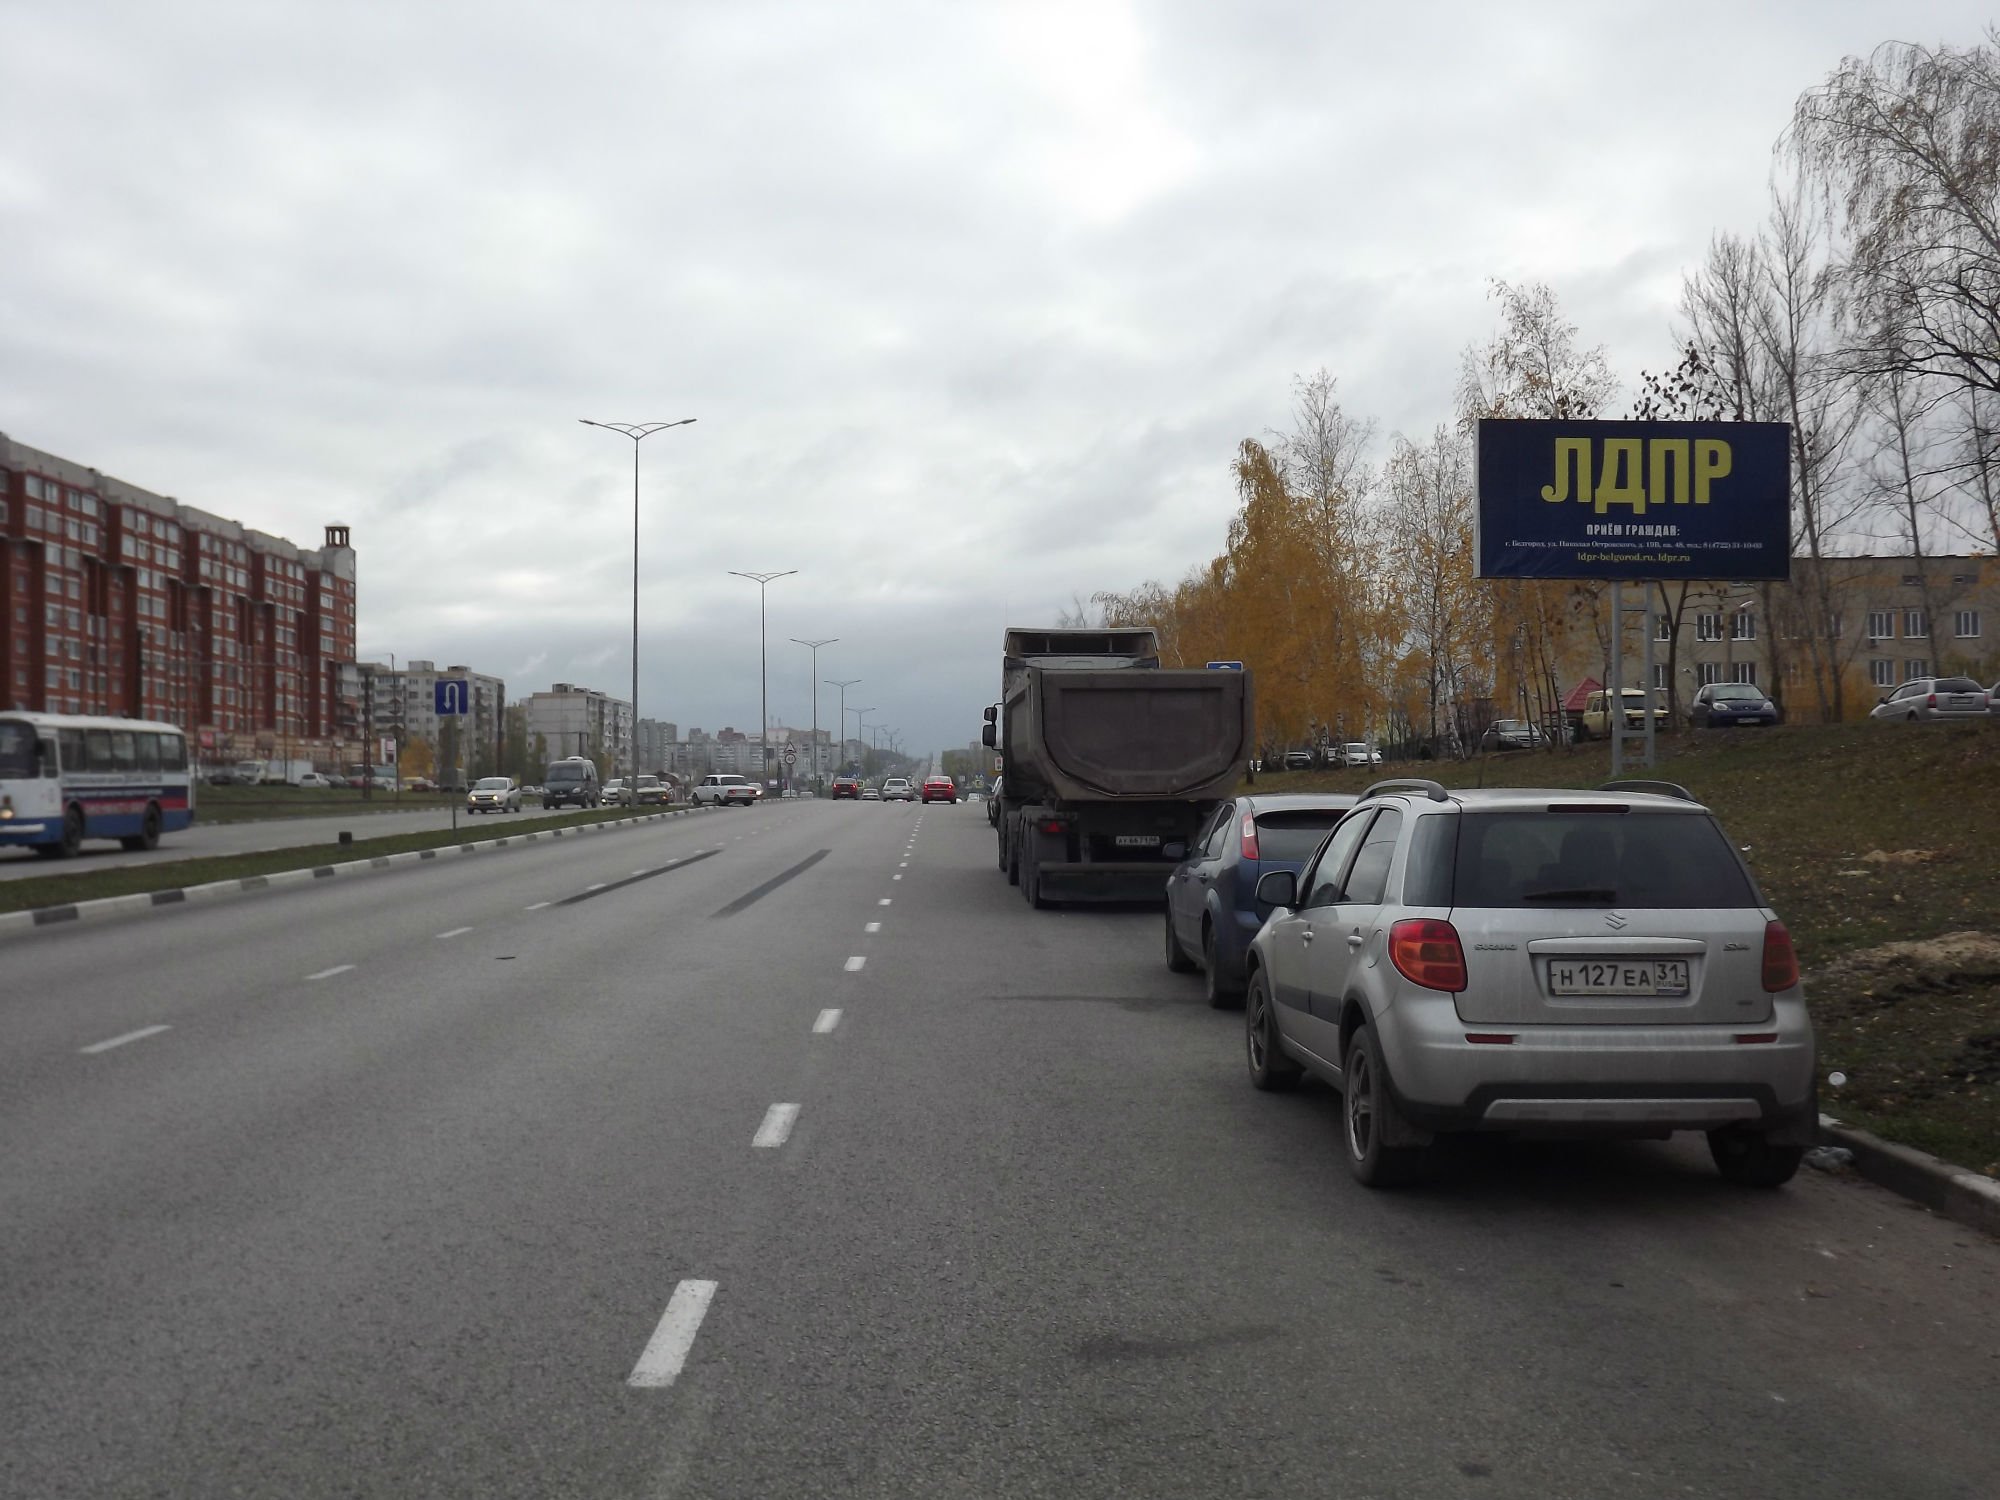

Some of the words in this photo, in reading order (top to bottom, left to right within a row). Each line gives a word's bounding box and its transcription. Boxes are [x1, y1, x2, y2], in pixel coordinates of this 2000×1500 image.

[1540, 437, 1732, 514] ЛДПР
[1586, 522, 1622, 536] ПРИЁМ
[1625, 524, 1680, 537] ГРАЖДАН:
[1658, 553, 1691, 563] ldpr.ru
[1657, 963, 1678, 981] 31
